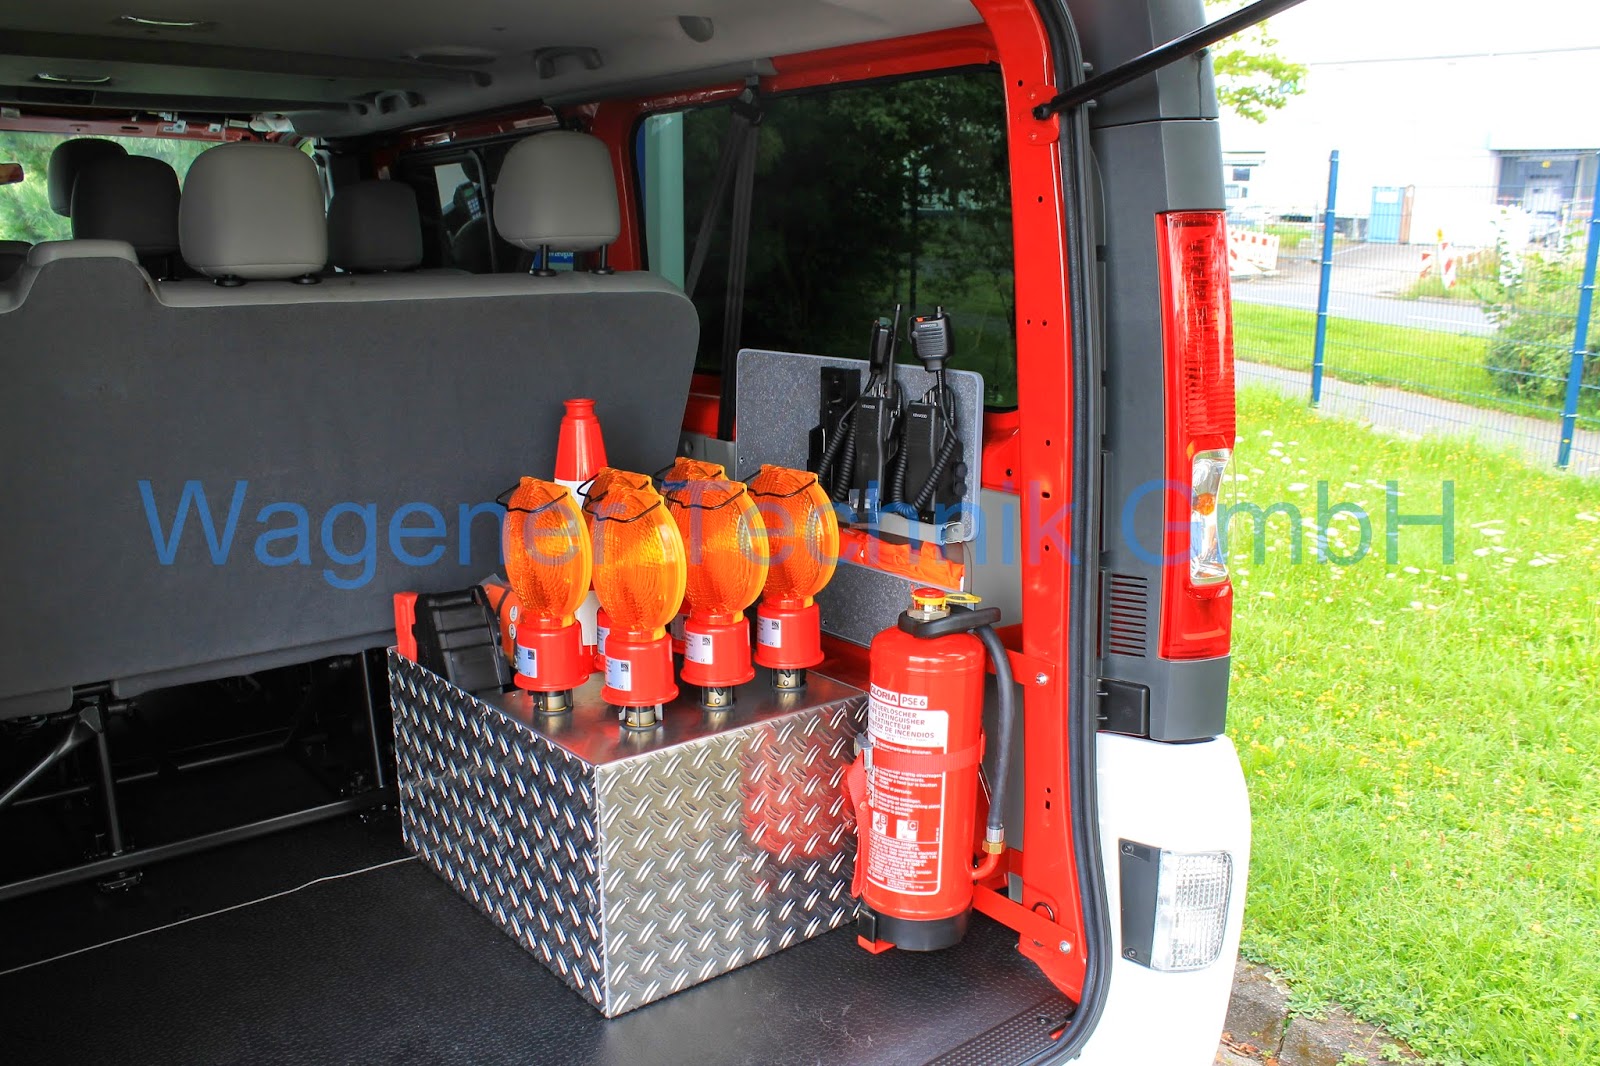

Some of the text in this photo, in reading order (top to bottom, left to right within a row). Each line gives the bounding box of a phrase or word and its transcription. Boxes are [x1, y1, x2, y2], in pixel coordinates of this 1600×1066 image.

[870, 685, 926, 707] GLORIA PSE 6
[875, 716, 911, 730] EXTINCTEUR
[878, 711, 926, 726] EXTINGUISHER
[884, 726, 893, 734] DE
[894, 729, 935, 739] INCENDIOS
[908, 822, 917, 830] C
